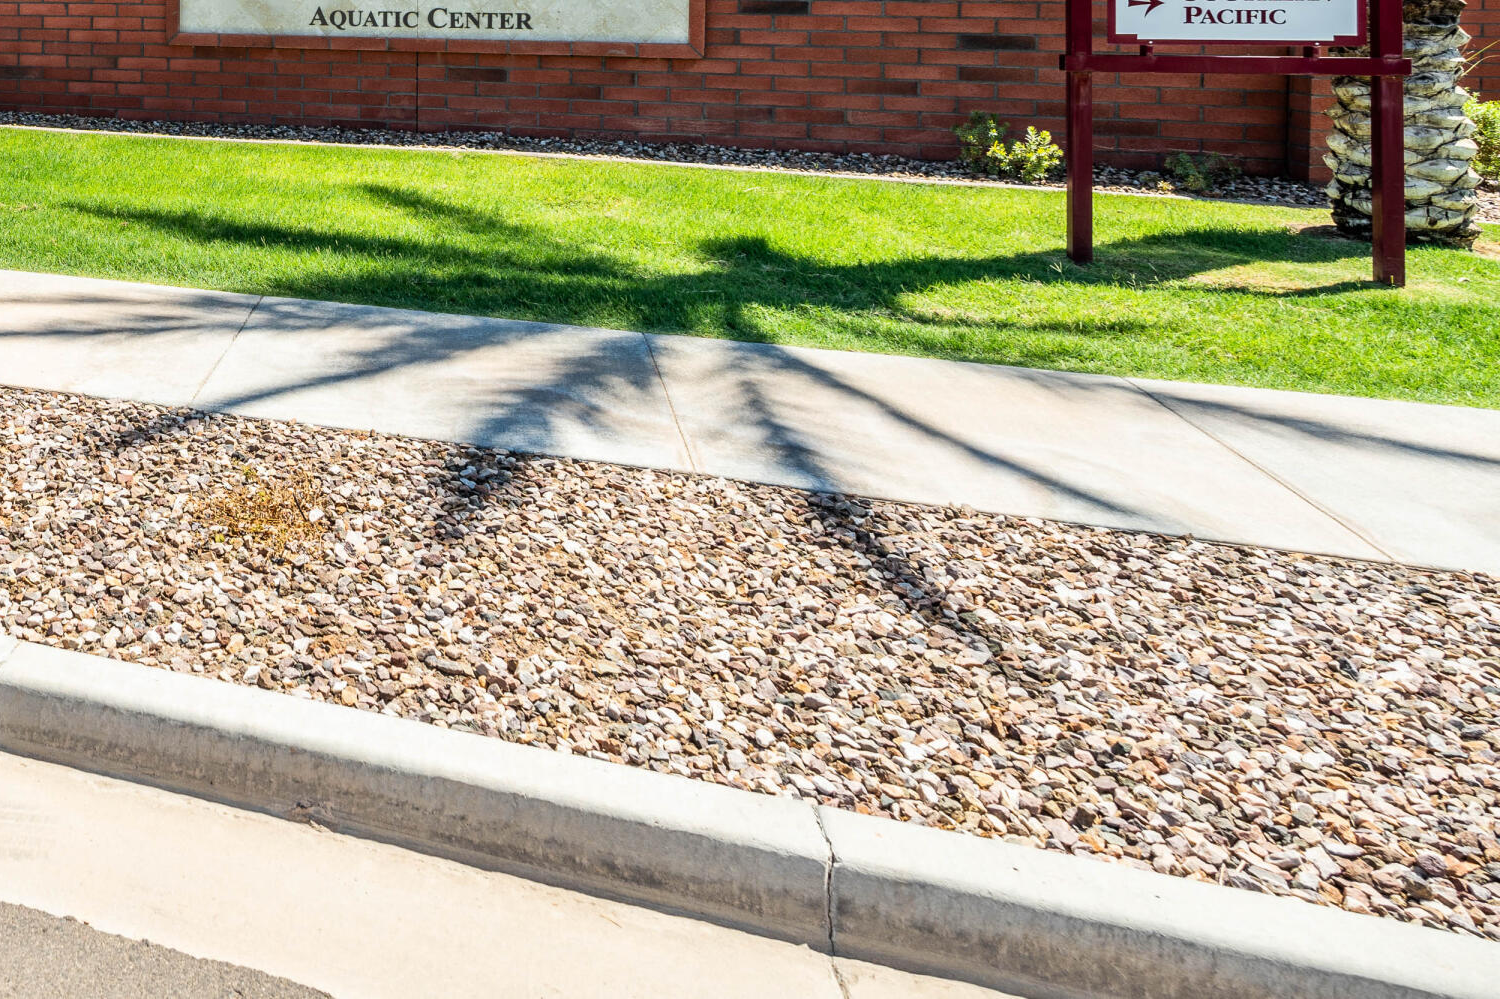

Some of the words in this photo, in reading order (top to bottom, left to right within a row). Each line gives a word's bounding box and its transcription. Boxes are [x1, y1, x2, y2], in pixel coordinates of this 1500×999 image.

[309, 6, 419, 30] AQUATIC
[427, 7, 533, 30] CENTER
[1183, 6, 1287, 25] PACIFIC
